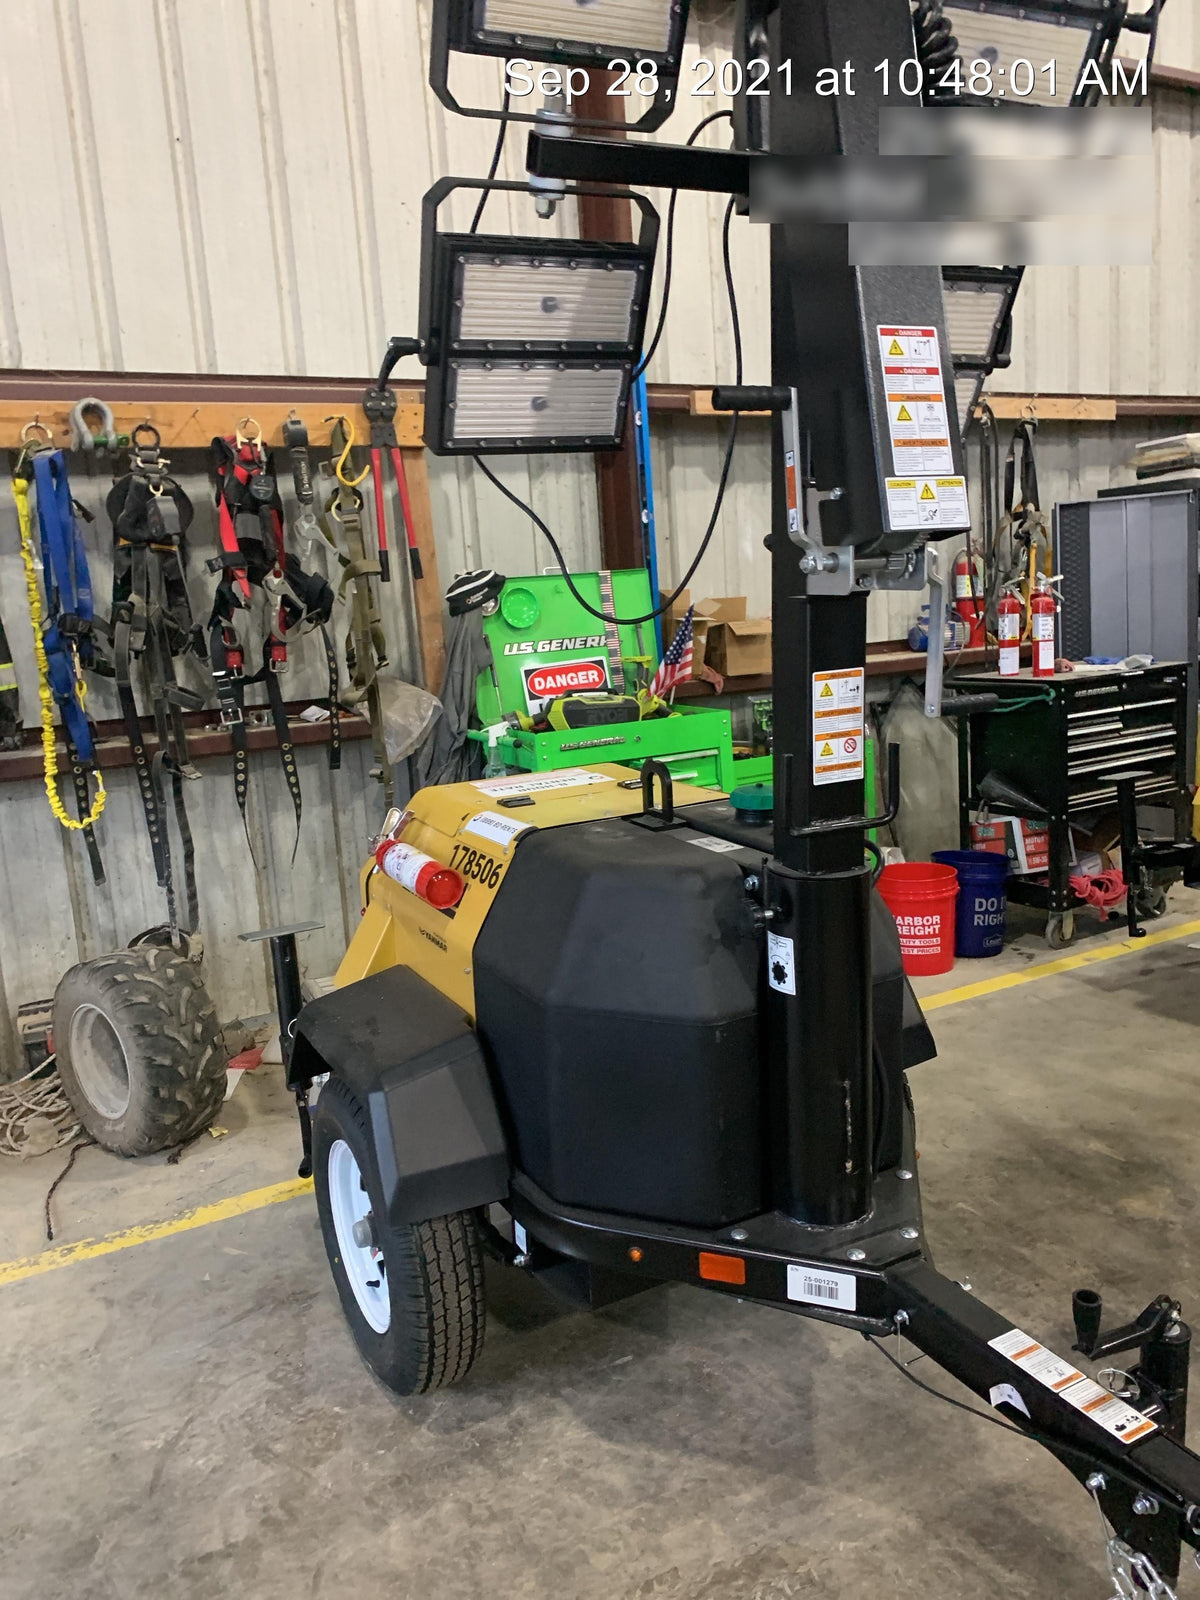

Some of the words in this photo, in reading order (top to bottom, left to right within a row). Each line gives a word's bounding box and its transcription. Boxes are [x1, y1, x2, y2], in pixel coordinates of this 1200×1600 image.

[503, 641, 535, 656] U.S.
[536, 635, 608, 653] GENER
[533, 669, 600, 691] DANGER
[450, 844, 504, 890] 178506
[974, 897, 998, 912] DO
[893, 914, 941, 926] ARBOR
[973, 912, 1004, 926] RIGH
[896, 925, 941, 936] REIGHT
[919, 938, 940, 946] TOOLS
[803, 1275, 839, 1288] 25-001279
